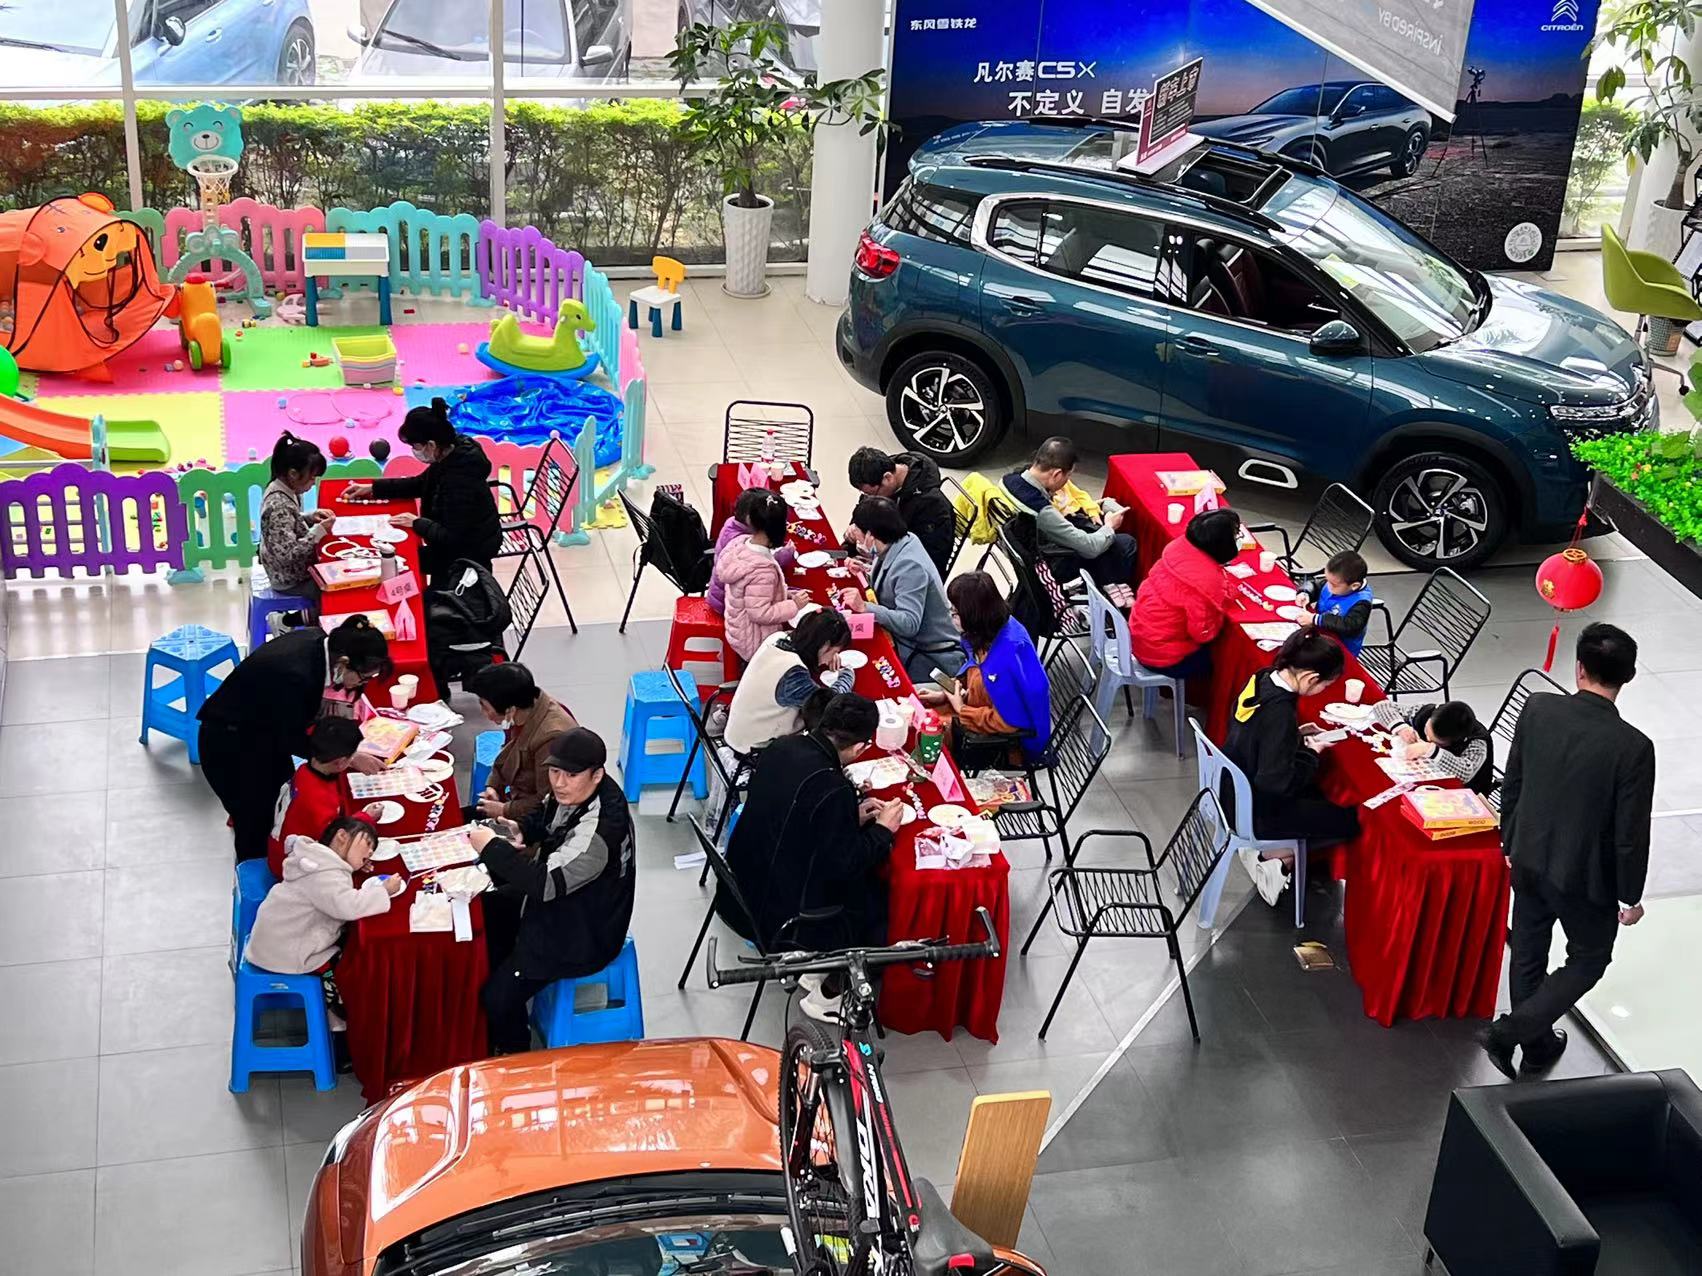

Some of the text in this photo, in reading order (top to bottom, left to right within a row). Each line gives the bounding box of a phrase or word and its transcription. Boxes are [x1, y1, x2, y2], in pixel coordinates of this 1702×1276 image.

[910, 17, 977, 31] 东风雪铁龙
[1008, 90, 1085, 117] 不定义
